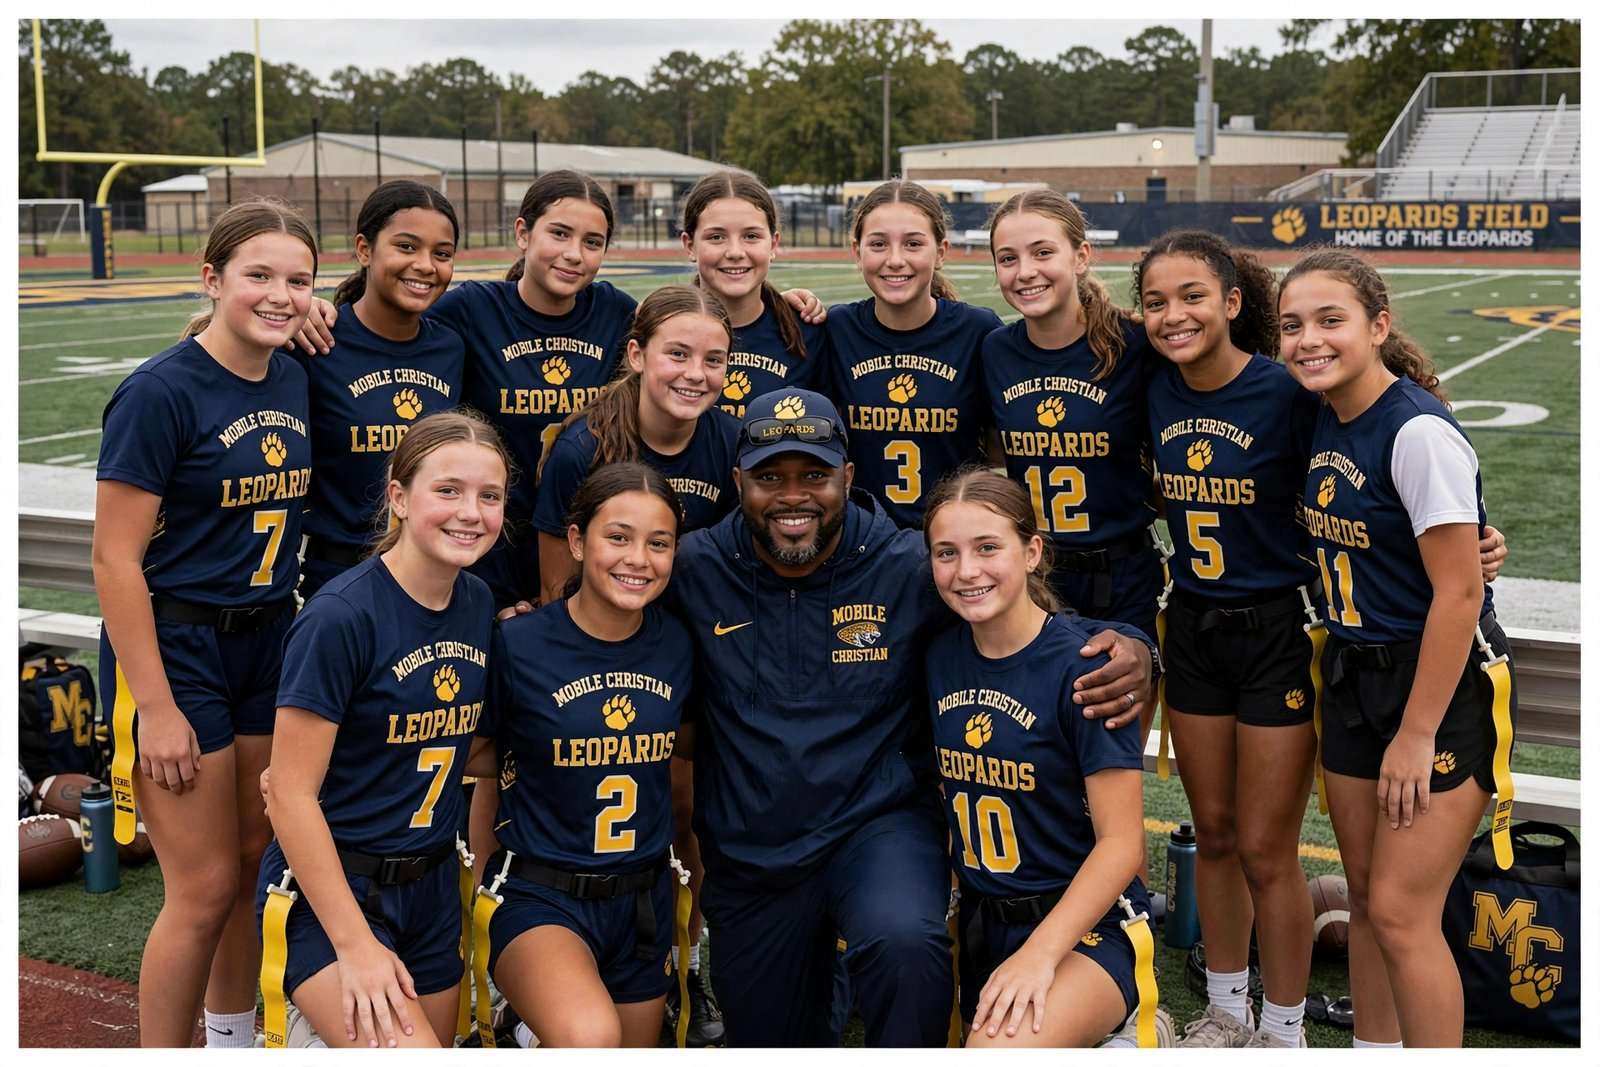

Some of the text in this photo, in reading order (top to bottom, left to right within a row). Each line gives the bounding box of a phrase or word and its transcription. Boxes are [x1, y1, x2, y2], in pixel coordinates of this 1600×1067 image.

[1320, 204, 1550, 229] LEOPARDS FIELD
[1334, 230, 1534, 247] HOME OF THE LEOPARDS
[502, 337, 604, 362] MOBILE CHRISTIAN
[727, 352, 788, 379] CHRISTIAN
[348, 368, 451, 398] MOBILE CHRISTIAN
[850, 354, 958, 382] MOBILE CHRISTIAN
[1003, 376, 1108, 405] MOBILE CHRISTIAN
[218, 410, 307, 449] MOBILE CHRISTIAN
[848, 404, 959, 433] LEOPARDS
[1160, 418, 1255, 450] MOBILE CHRISTIAN
[1001, 430, 1110, 457] LEOPARDS
[221, 467, 312, 508] LEOPARD
[883, 439, 922, 504] 3
[665, 477, 721, 503] HRISTIAN
[1024, 465, 1091, 533] 12
[249, 508, 288, 587] 7
[1185, 510, 1225, 580] 5
[831, 603, 887, 626] MOBILE
[391, 641, 487, 682] MOBILE CHRISTIAN
[831, 647, 888, 664] CHRISTIAN
[552, 672, 673, 708] MOBILE CHRISTIAN
[386, 700, 484, 744] LEOPARD
[937, 688, 1038, 731] MOBILE CHRISTIAN
[552, 731, 676, 768] LEOPARDS
[408, 746, 457, 829] 7
[593, 774, 638, 854] 2
[951, 791, 1021, 874] 10
